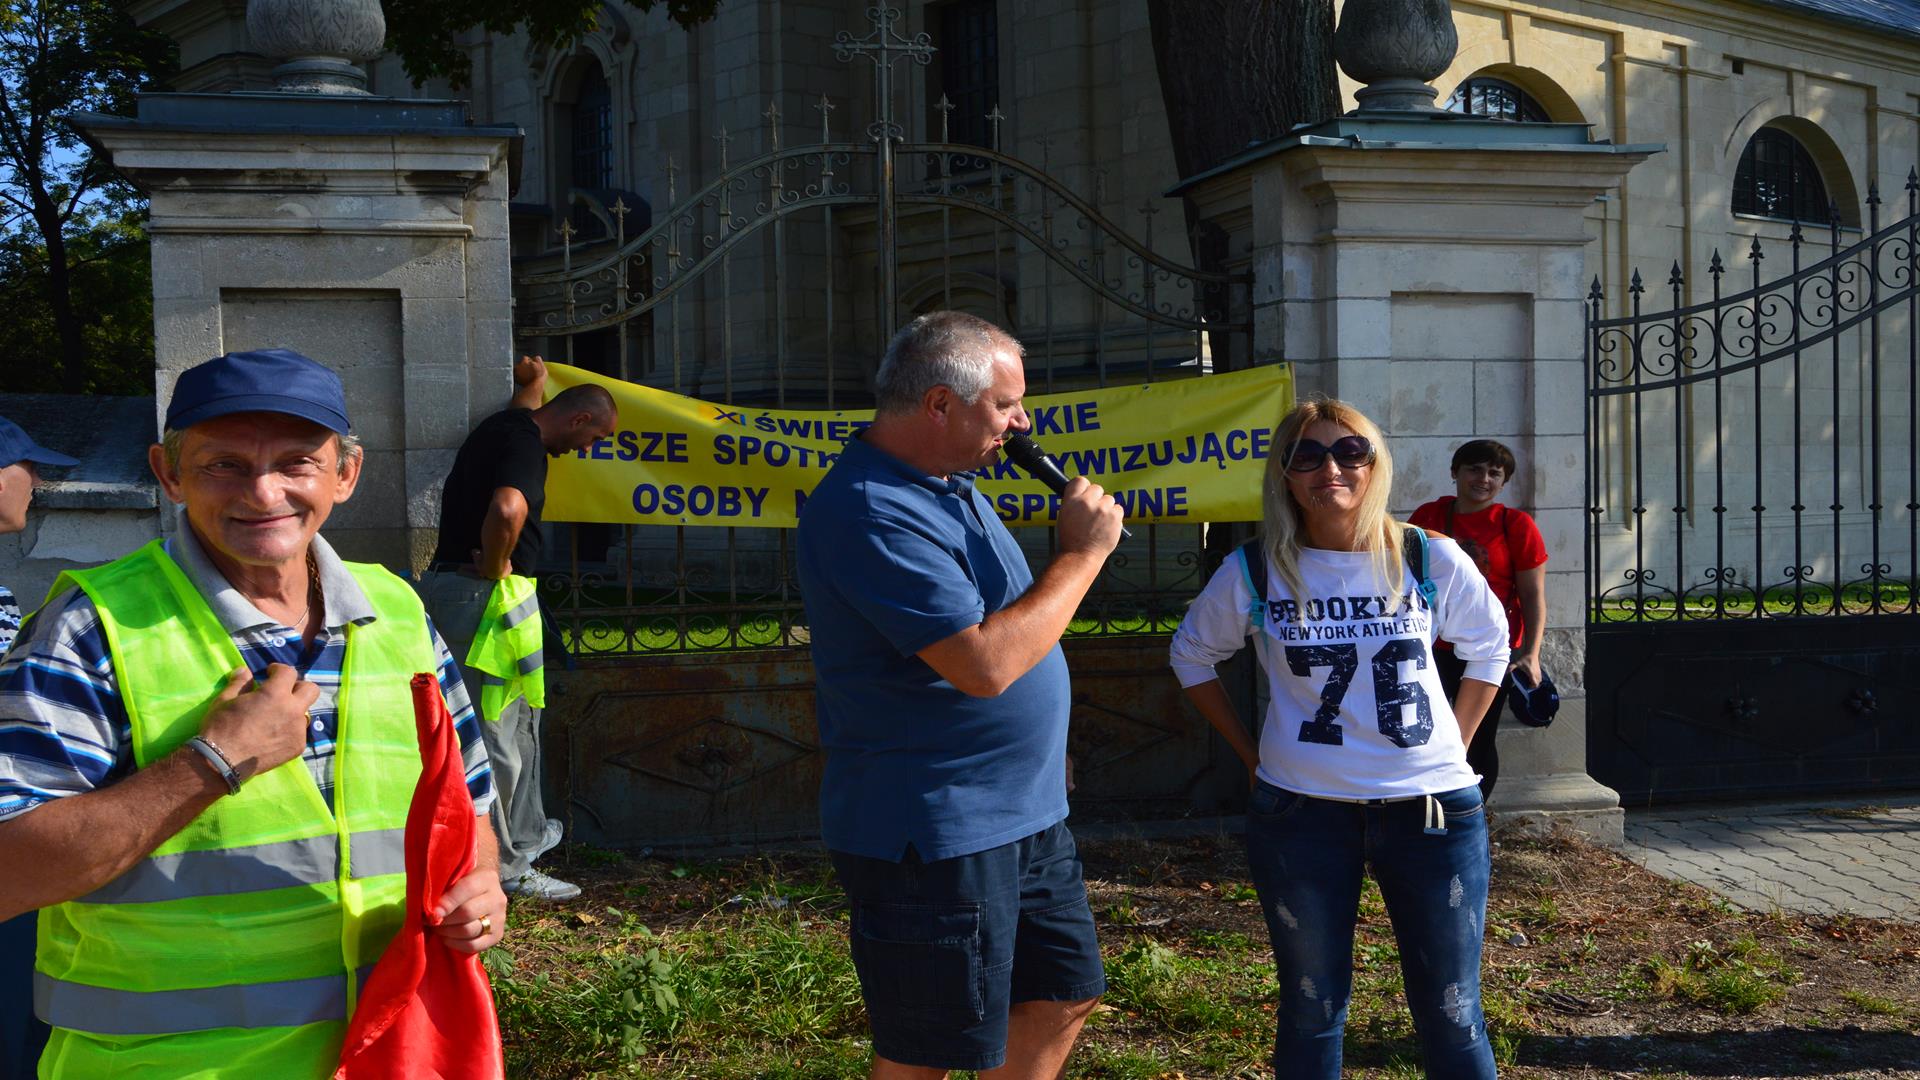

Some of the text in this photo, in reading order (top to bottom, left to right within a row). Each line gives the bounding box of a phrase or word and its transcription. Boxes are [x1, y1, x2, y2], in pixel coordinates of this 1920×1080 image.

[713, 406, 747, 427] XI
[578, 431, 689, 463] ESZE
[713, 434, 841, 468] SPOTK
[632, 484, 770, 518] OSOBY
[1362, 617, 1428, 638] ATHLETIC
[1285, 638, 1434, 748] 76
